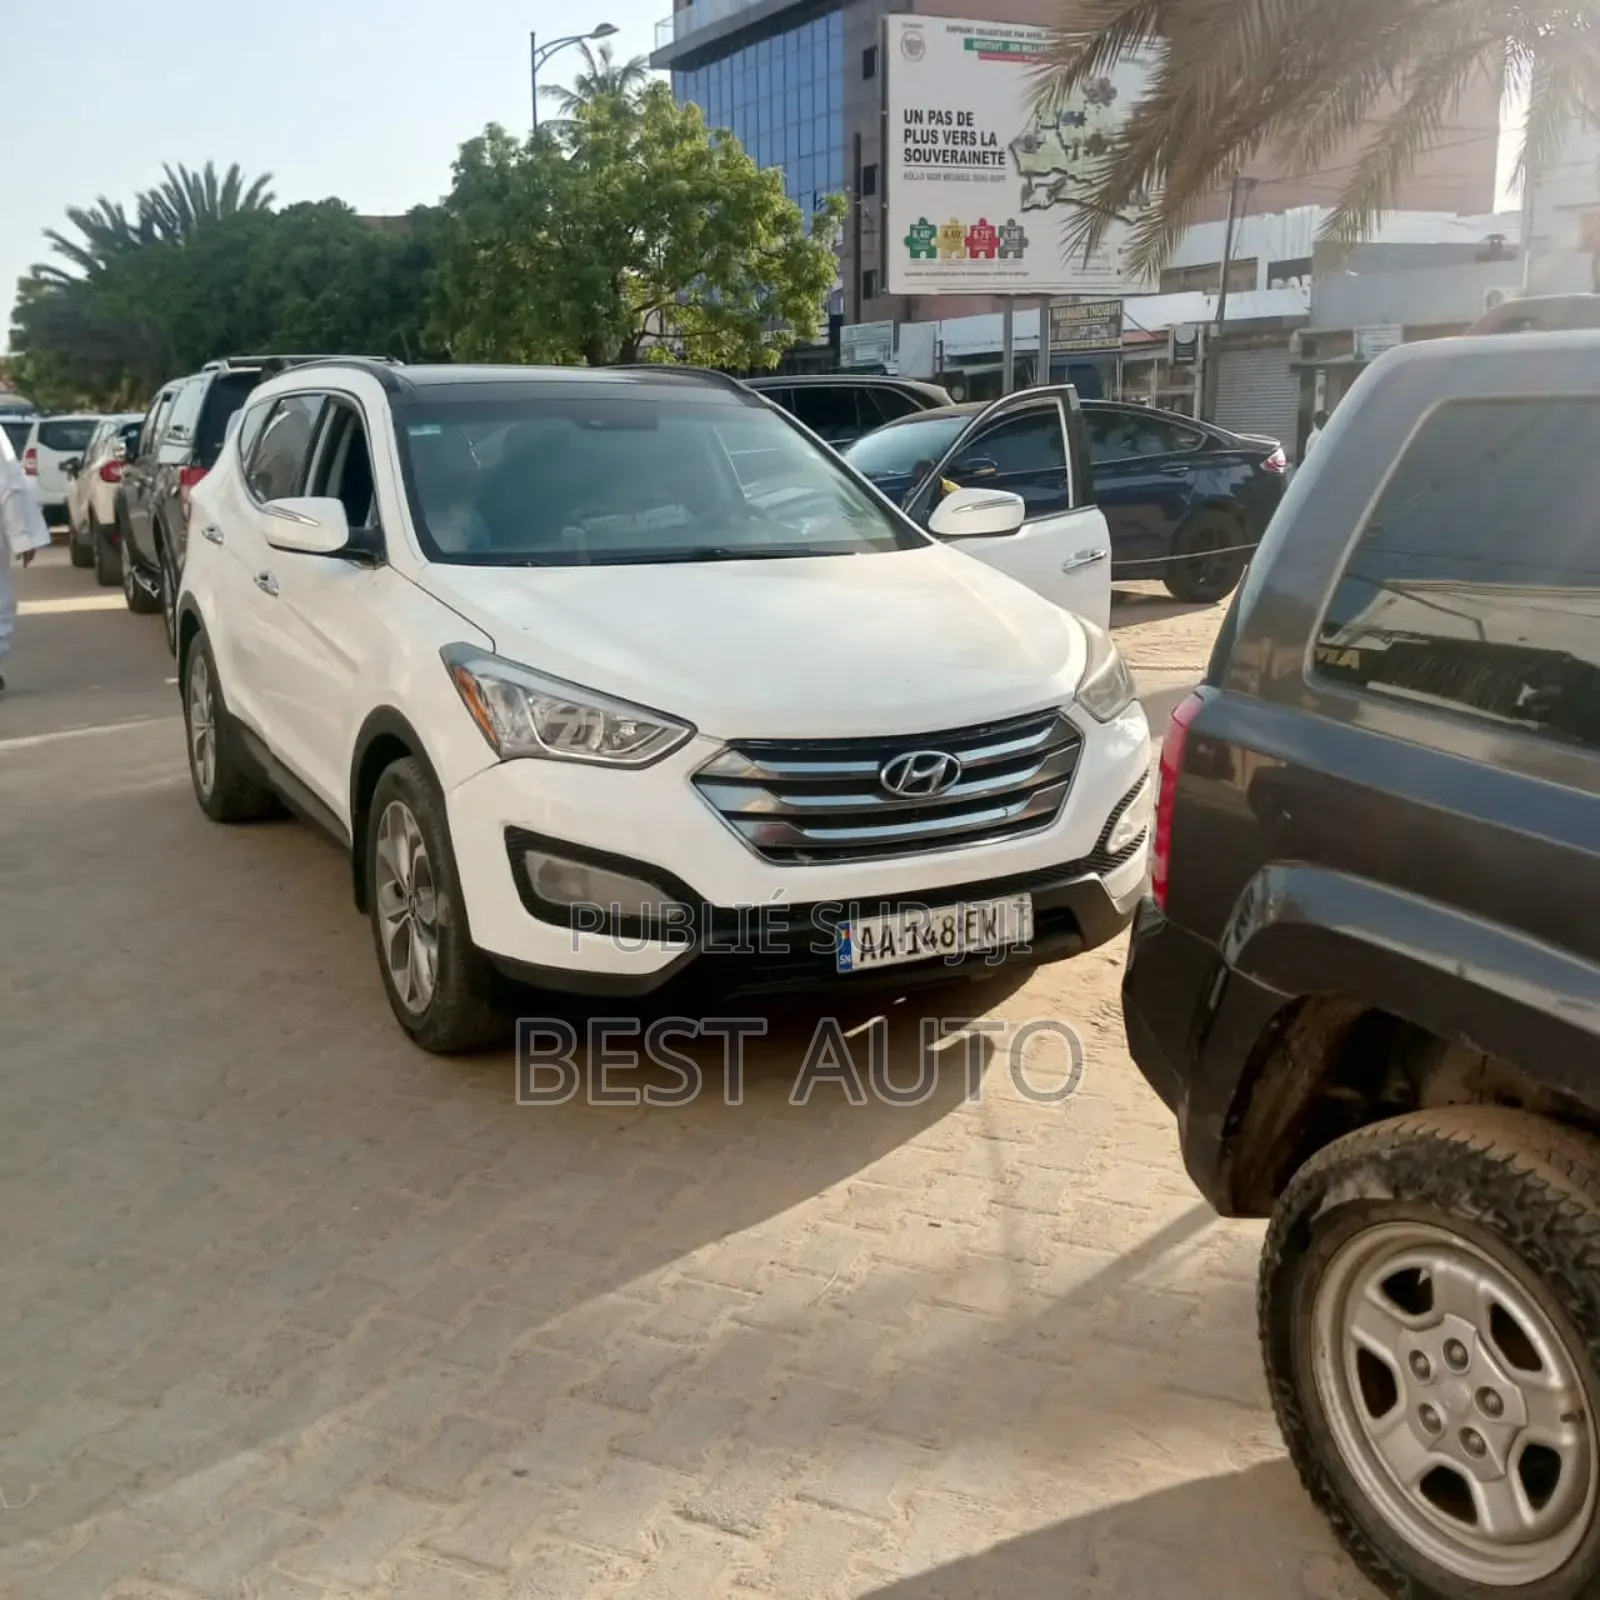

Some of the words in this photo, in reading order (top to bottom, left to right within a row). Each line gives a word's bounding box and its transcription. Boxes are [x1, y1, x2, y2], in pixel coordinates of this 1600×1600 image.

[904, 109, 923, 124] UN
[928, 110, 953, 126] PAS
[956, 111, 974, 126] DE
[904, 128, 939, 145] PLUS
[942, 129, 977, 146] VERS
[980, 131, 997, 147] LA
[904, 147, 1006, 165] SOUVERAINETÉ
